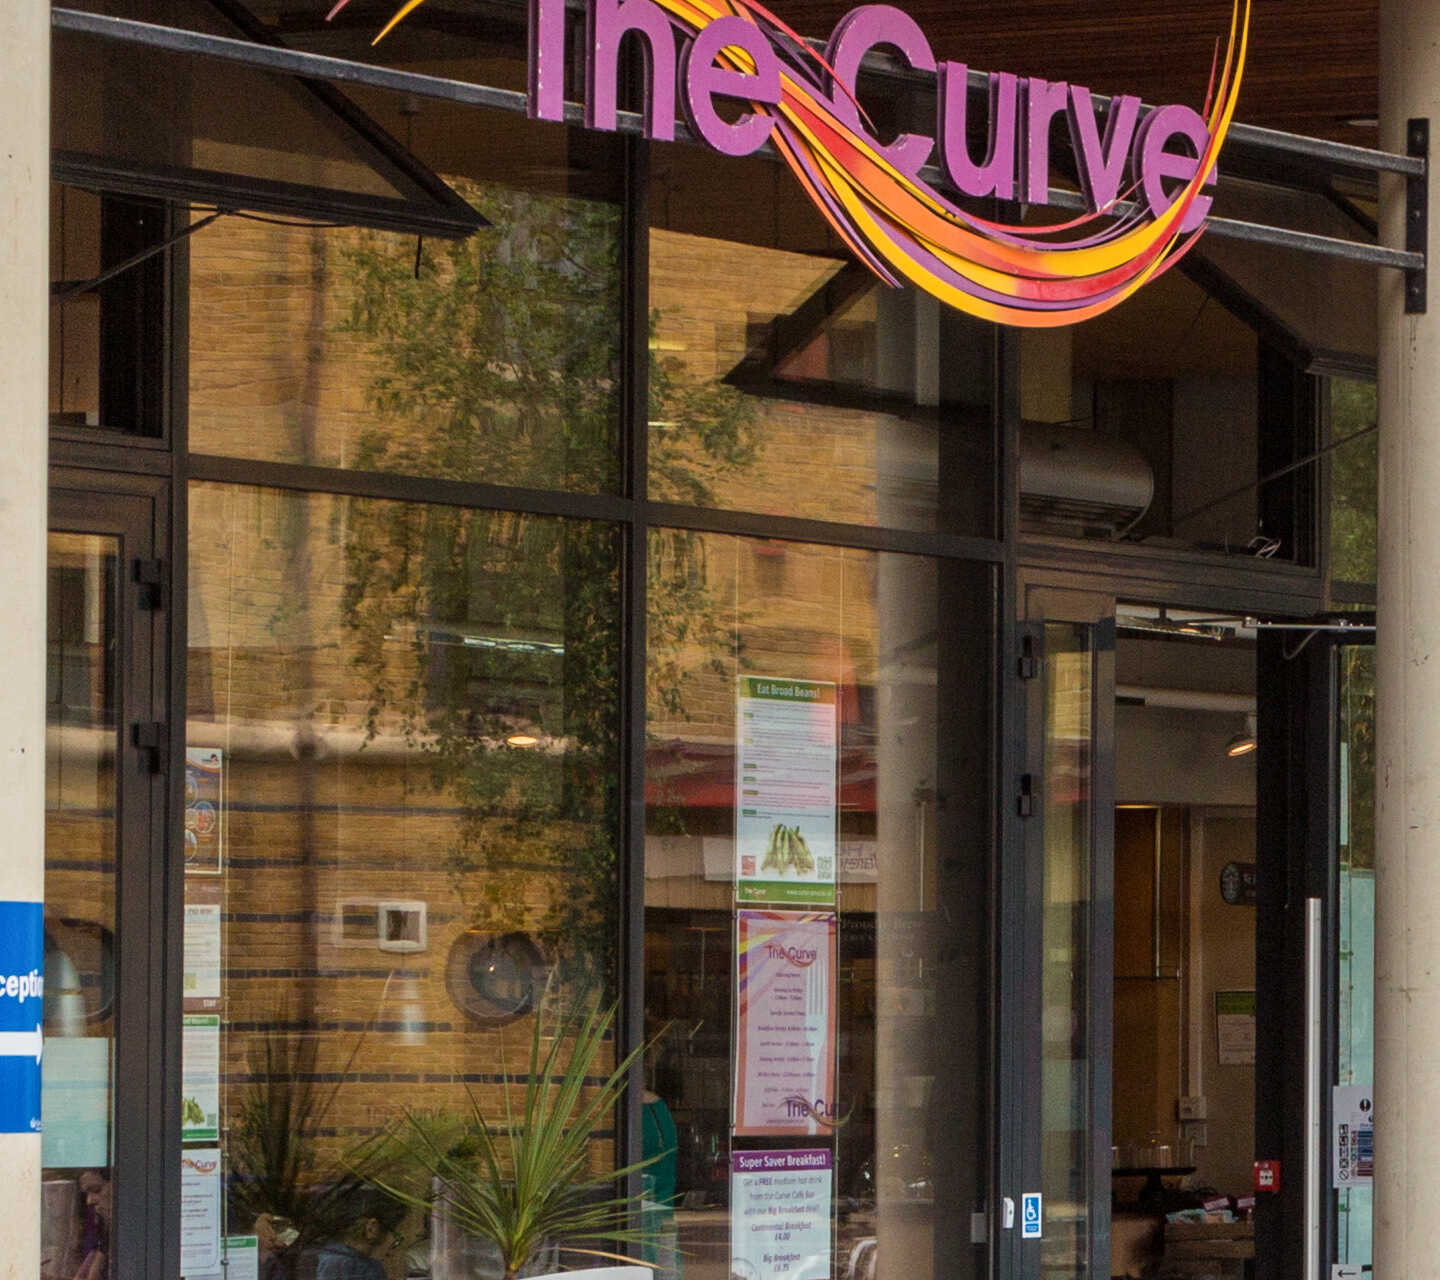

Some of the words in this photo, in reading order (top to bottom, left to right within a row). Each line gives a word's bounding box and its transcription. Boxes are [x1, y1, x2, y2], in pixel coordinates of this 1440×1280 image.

[823, 4, 1217, 233] Curve
[768, 945, 785, 960] The
[788, 946, 817, 961] Curve
[740, 1156, 763, 1170] Super
[764, 1155, 786, 1167] Saver
[787, 1153, 827, 1167] Breakfast!
